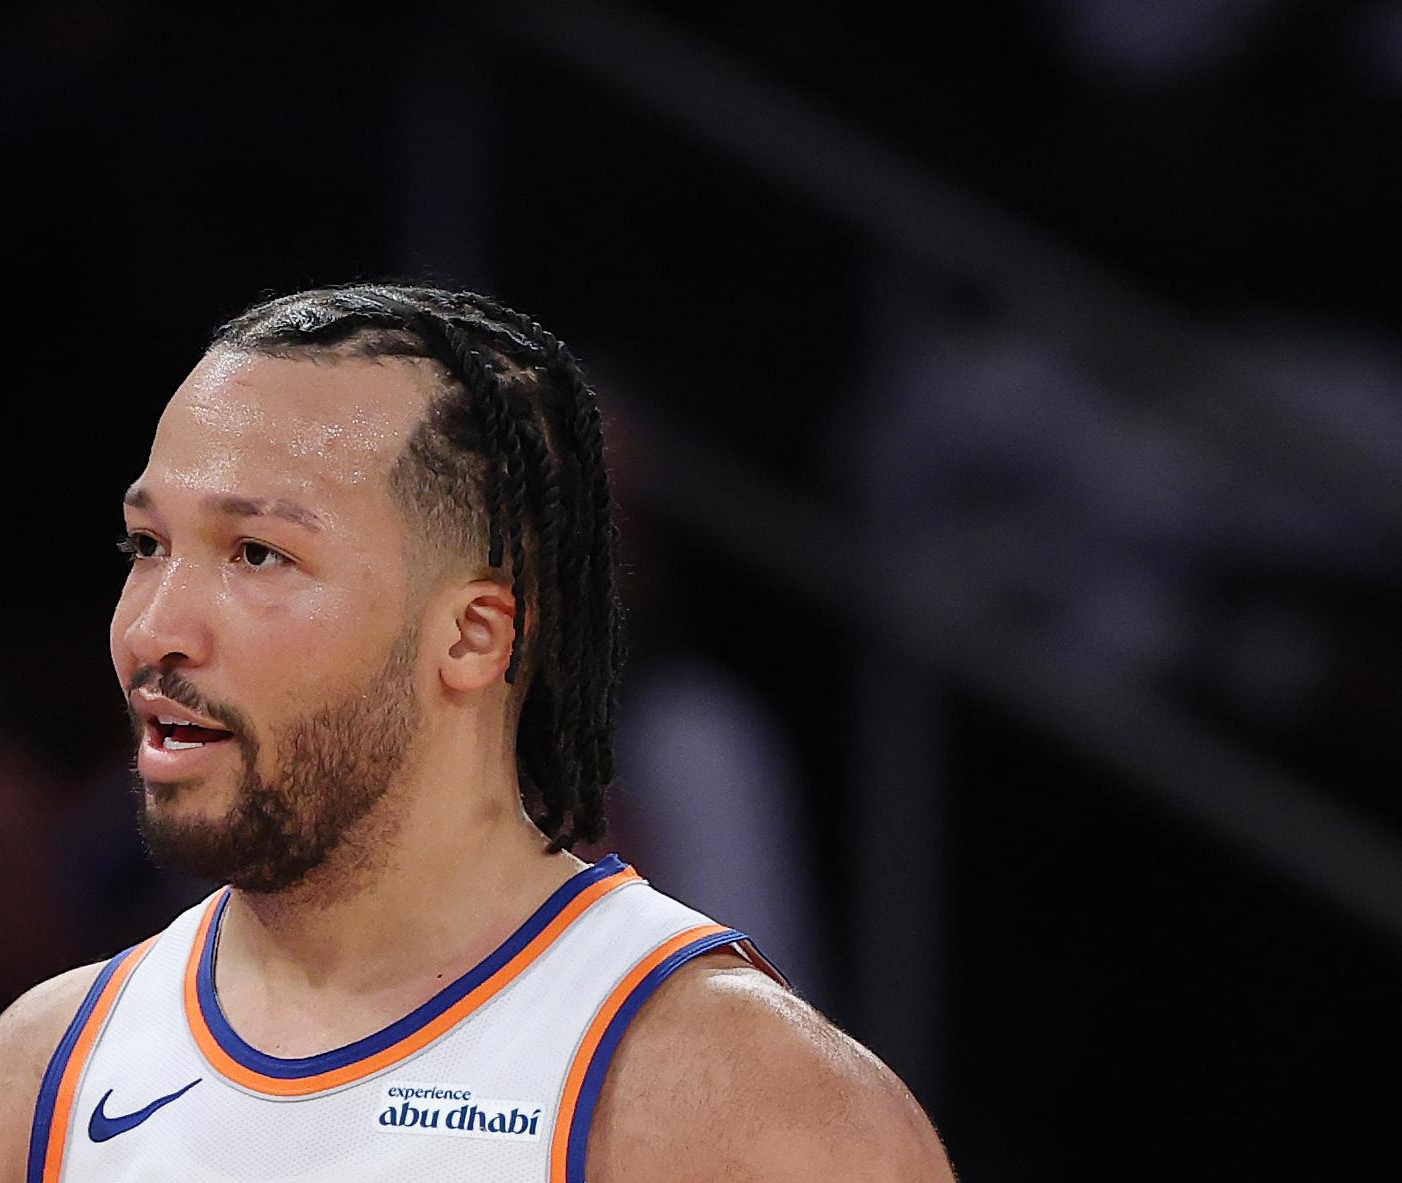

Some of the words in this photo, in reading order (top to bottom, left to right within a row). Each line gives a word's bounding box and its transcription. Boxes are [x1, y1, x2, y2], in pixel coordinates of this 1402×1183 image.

[387, 1086, 471, 1101] experience
[378, 1101, 440, 1129] abu
[445, 1104, 542, 1136] dhabi
